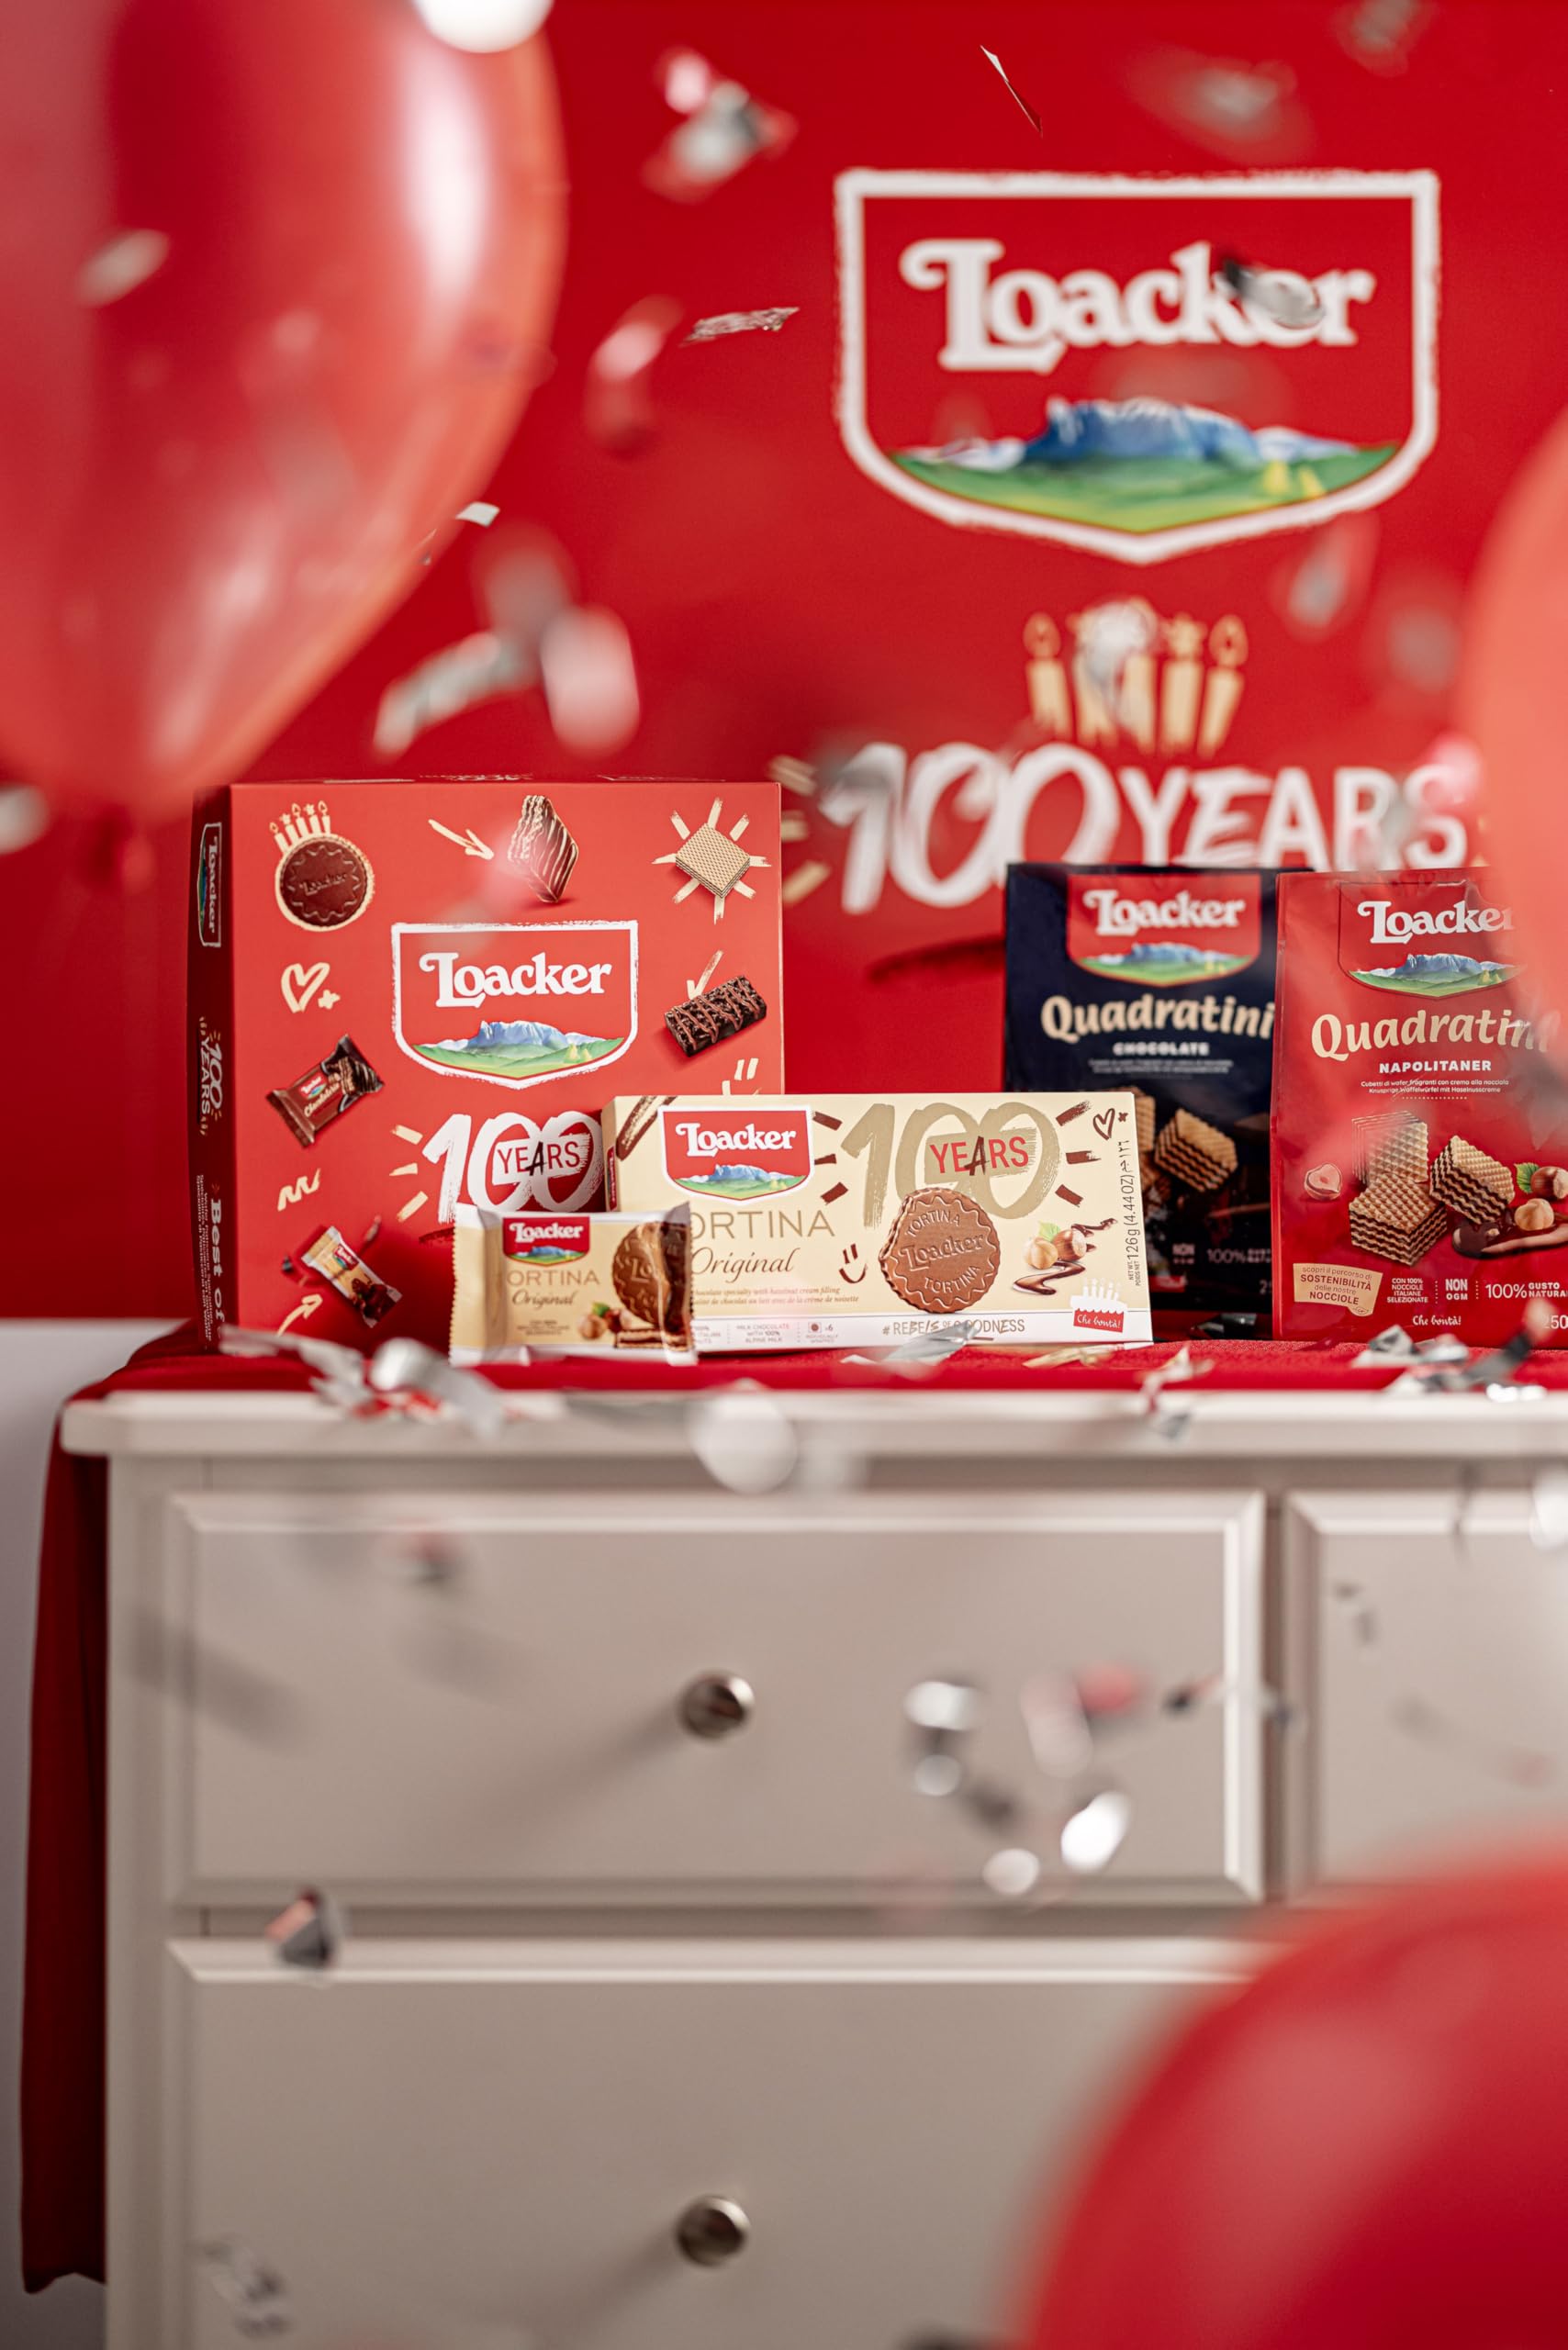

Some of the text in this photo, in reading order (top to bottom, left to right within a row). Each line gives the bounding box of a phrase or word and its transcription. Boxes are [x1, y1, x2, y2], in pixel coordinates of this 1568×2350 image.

[817, 741, 1470, 915] 100 YEARS
[208, 835, 218, 934] Loacker
[1083, 890, 1246, 936] Loacker
[419, 952, 612, 1008] Loacker
[1041, 994, 1275, 1044] Quadratini
[1113, 1043, 1210, 1056] CHOCOLATE
[200, 1036, 210, 1114] YEARS
[208, 1043, 222, 1110] 100
[1379, 1060, 1492, 1073] NAPOLITANER
[675, 1123, 797, 1158] Loacker
[421, 1111, 603, 1225] 100
[497, 1141, 580, 1176] YEARS
[840, 1102, 1061, 1230] 100
[929, 1136, 1029, 1176] YEARS
[510, 1222, 584, 1243] Loacker
[690, 1211, 834, 1239] ORTINA
[905, 1210, 960, 1237] TORTINA
[211, 1199, 223, 1278] Best
[691, 1247, 801, 1283] Original
[898, 1235, 983, 1271] Loacker
[507, 1270, 600, 1285] ORTINA
[924, 1265, 980, 1293] TORTINA
[1300, 1274, 1372, 1291] SOSTENIBILITÀ
[1302, 1266, 1326, 1274] scopri
[1331, 1269, 1364, 1278] percorso
[1445, 1279, 1468, 1292] NON
[512, 1291, 578, 1309] Original
[1309, 1292, 1359, 1304] NOCCIOLE
[1333, 1286, 1357, 1295] nostre
[1485, 1283, 1527, 1299] 100%
[1077, 1312, 1092, 1325] Che
[1413, 1315, 1462, 1326] Che bontà!
